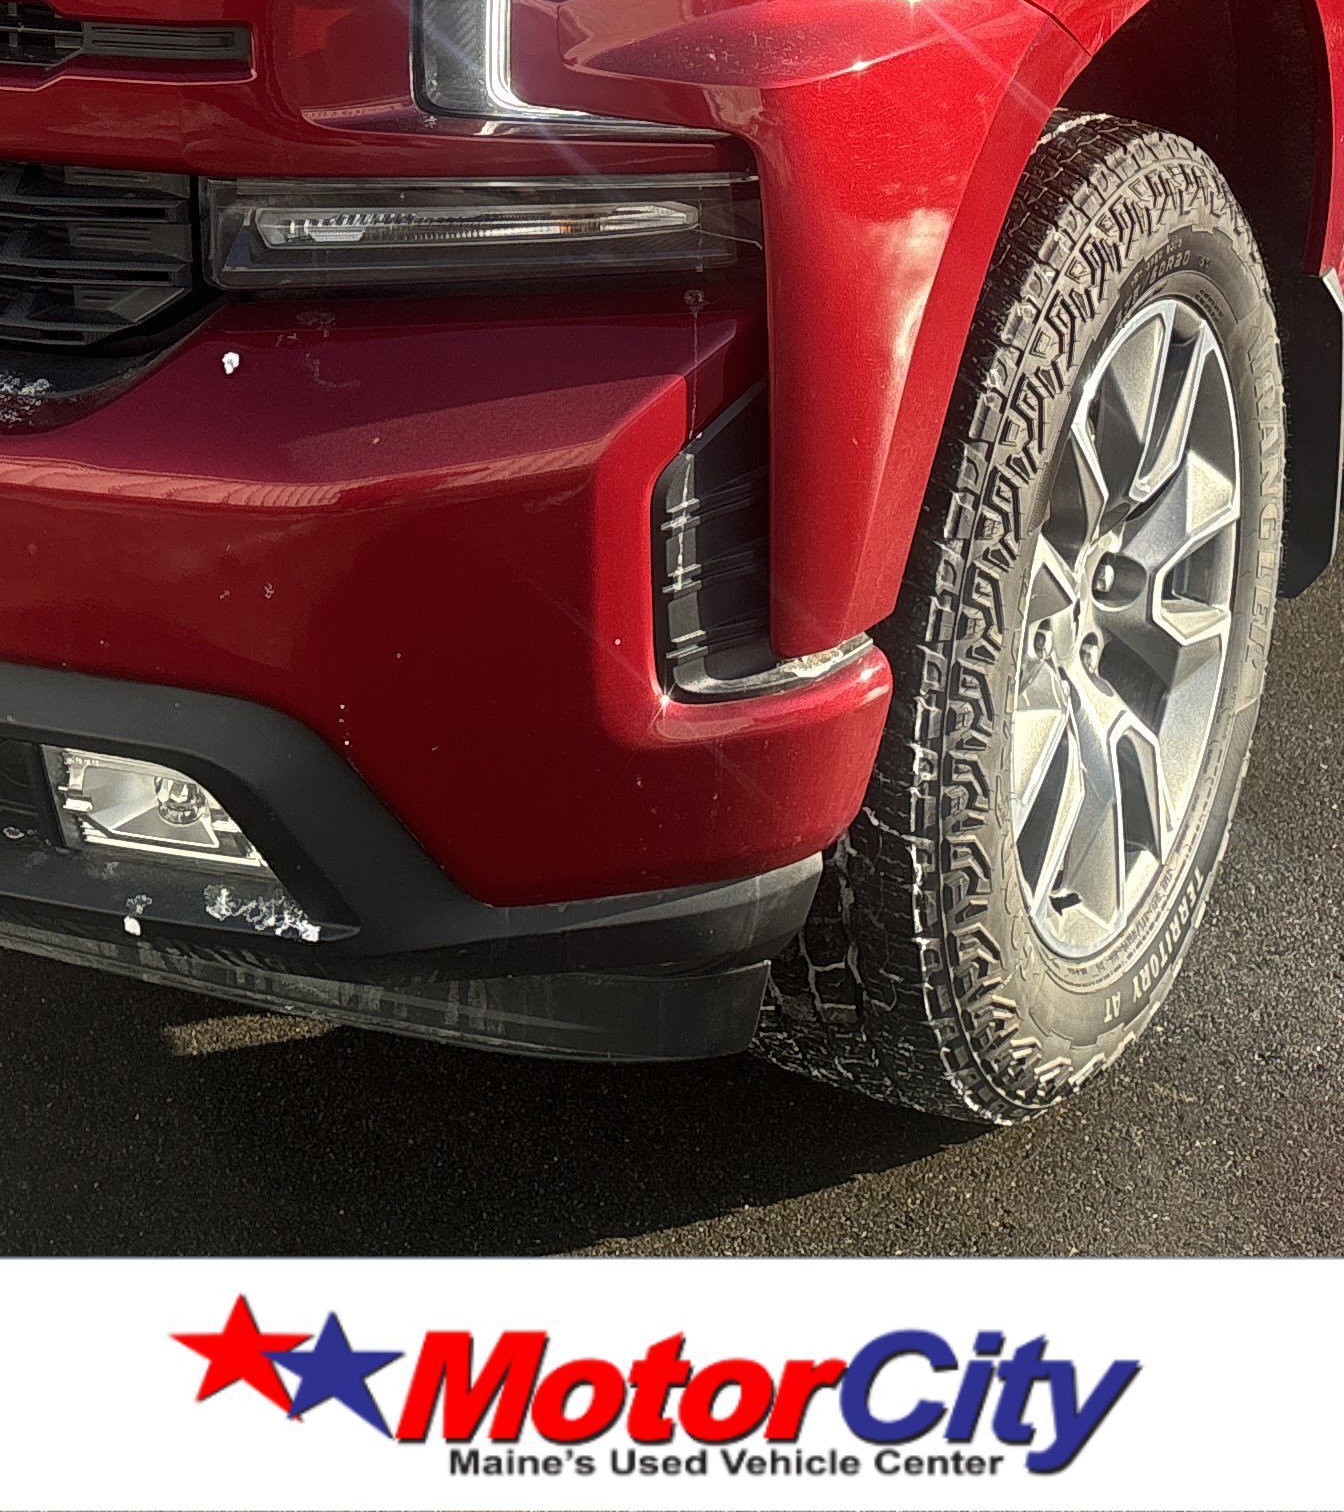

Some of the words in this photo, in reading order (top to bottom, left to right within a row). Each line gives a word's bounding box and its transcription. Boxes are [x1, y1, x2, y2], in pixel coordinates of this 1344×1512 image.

[1246, 326, 1281, 672] WRANGLER
[1132, 867, 1204, 1003] TERRITORY
[1104, 991, 1121, 1023] AT
